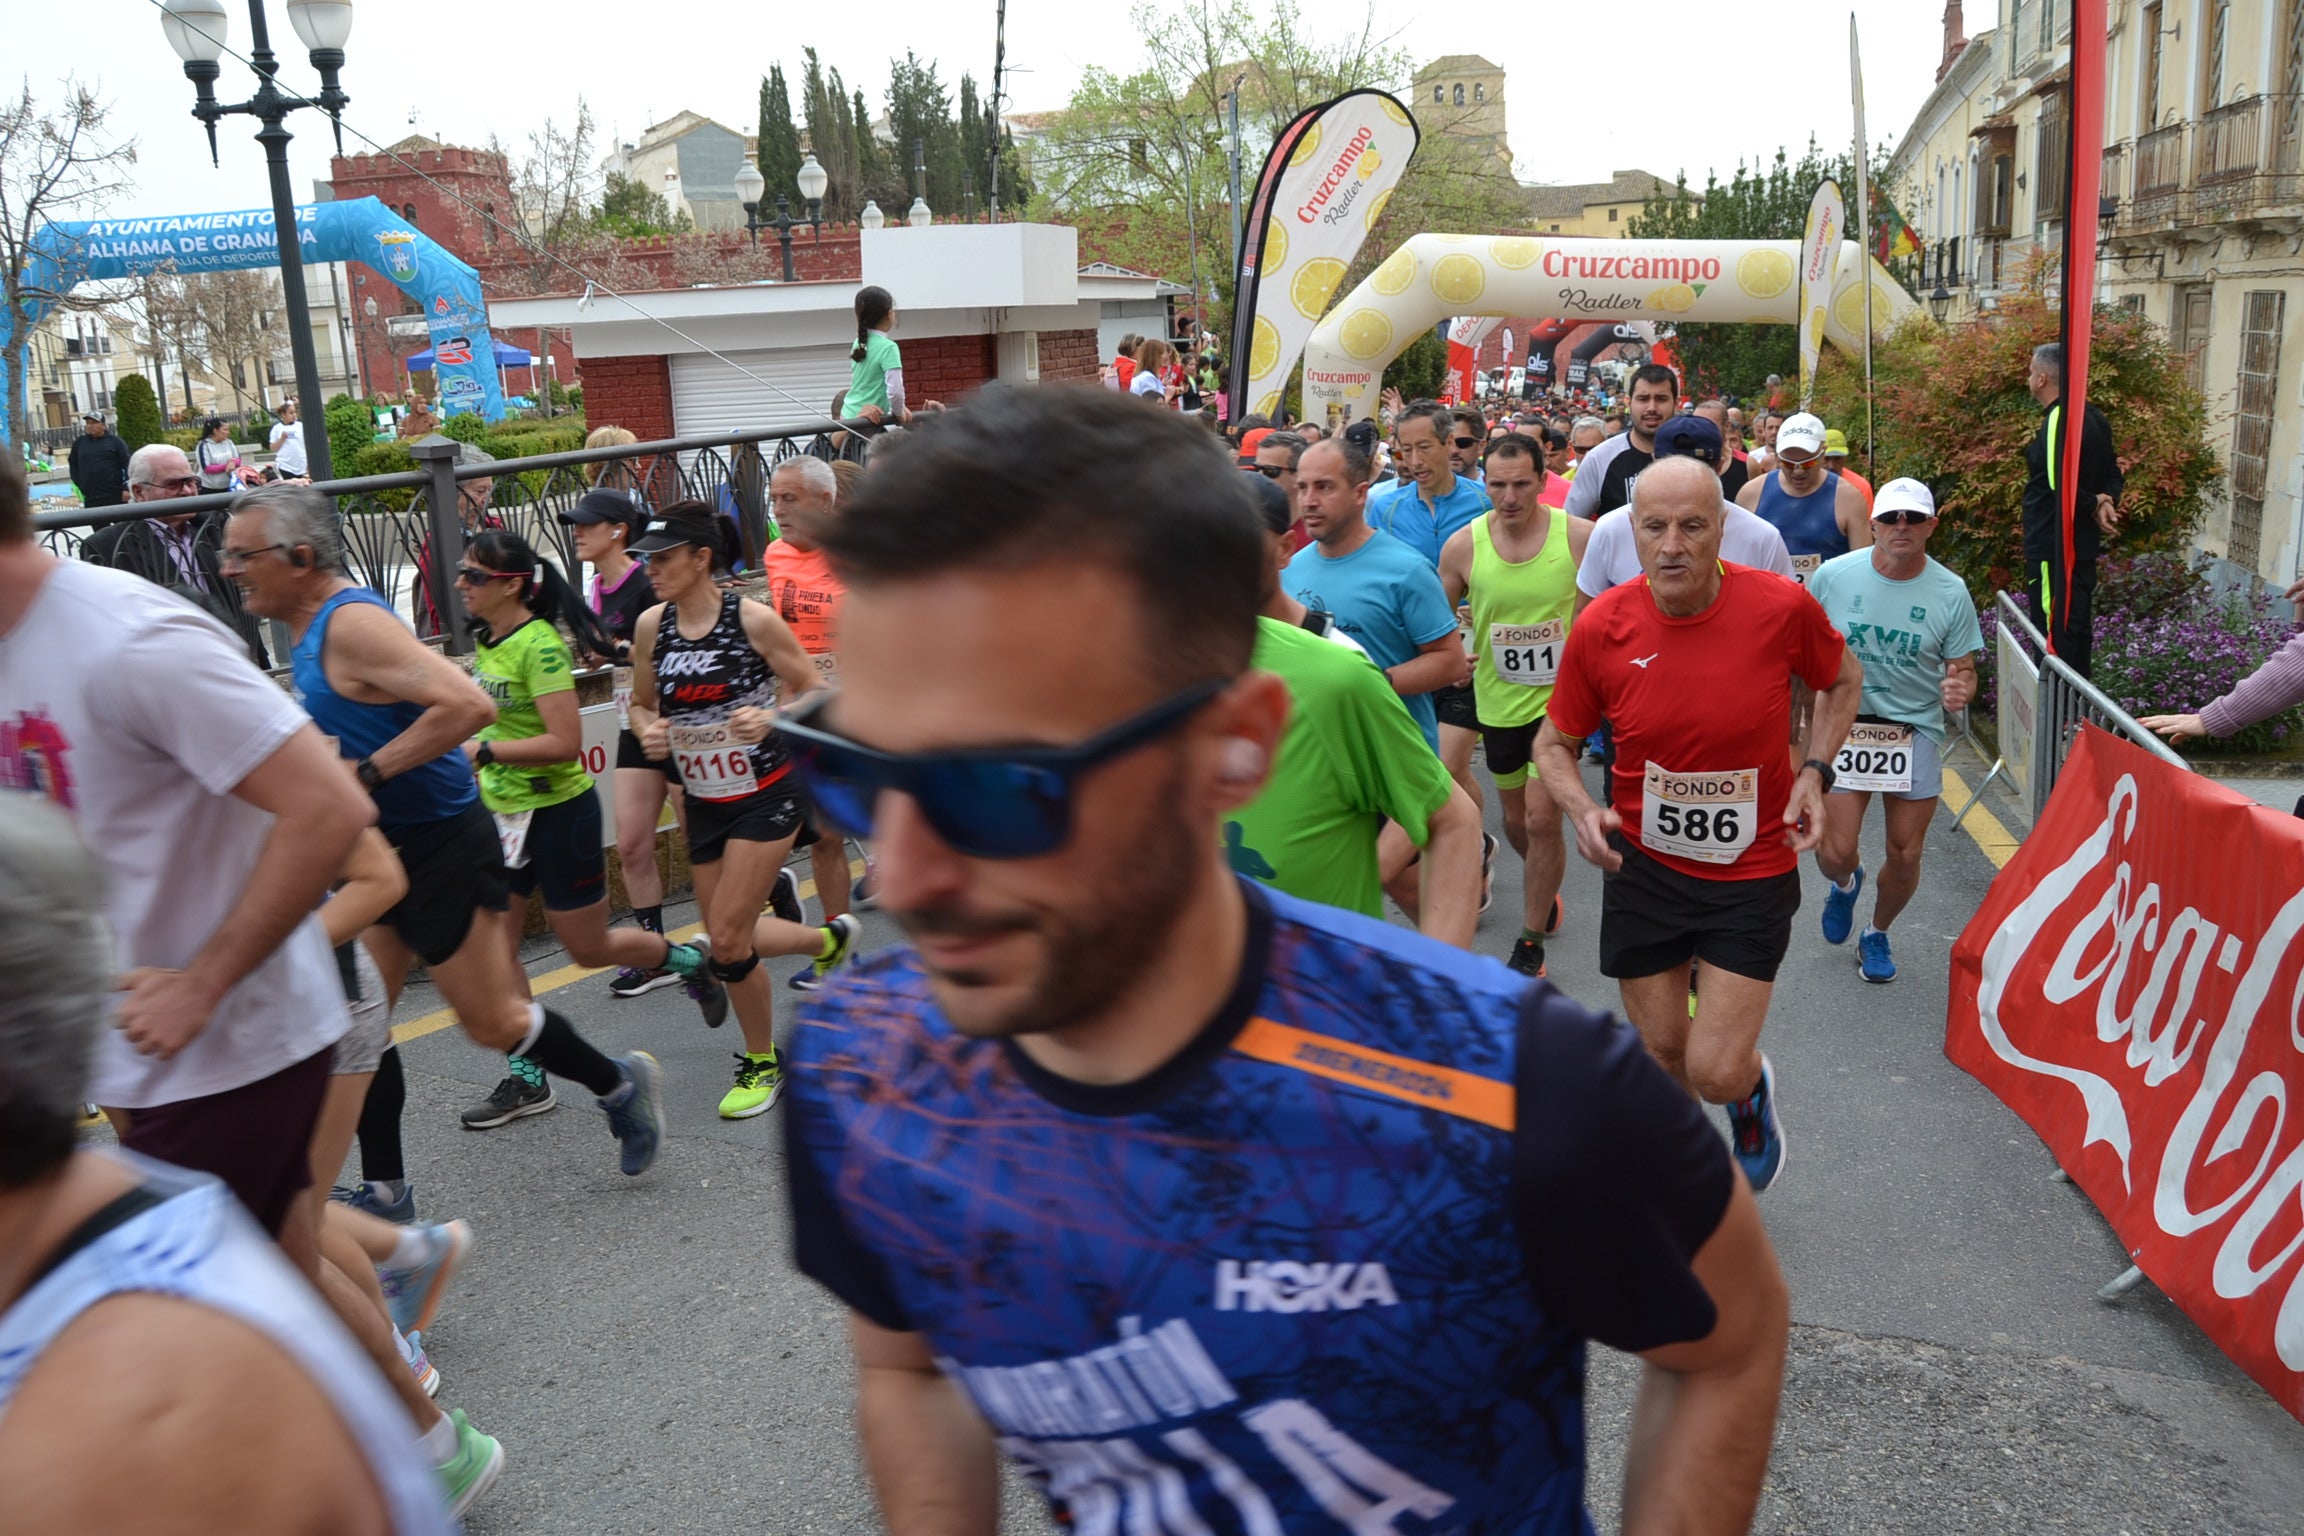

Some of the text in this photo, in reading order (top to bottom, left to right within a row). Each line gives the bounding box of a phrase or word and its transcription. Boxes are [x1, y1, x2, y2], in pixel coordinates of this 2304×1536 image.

[1297, 126, 1373, 224] Cruzcampo
[1323, 179, 1364, 225] Radler
[87, 210, 276, 236] AYUNTAMIENTO
[88, 238, 177, 259] ALHAMA
[180, 234, 208, 253] DE
[1808, 206, 1831, 282] Cruzcampo
[203, 254, 219, 265] DE
[222, 250, 281, 264] DEPORTE
[1542, 249, 1721, 284] Cruzcampo
[1558, 286, 1644, 313] Radler
[1456, 315, 1482, 339] DEPO
[1528, 352, 1549, 371] als
[1306, 367, 1371, 385] Cruzcampo
[1311, 384, 1342, 398] Radler
[1782, 427, 1813, 437] adidas
[1506, 627, 1551, 641] FONDO
[1846, 621, 1922, 657] XVII
[1504, 645, 1554, 672] 811
[1850, 728, 1899, 741] FONDO
[678, 750, 749, 781] 2116
[1837, 749, 1907, 775] 3020
[1664, 780, 1735, 796] FONDO
[1656, 803, 1740, 843] 586
[1213, 1259, 1399, 1314] HOKA
